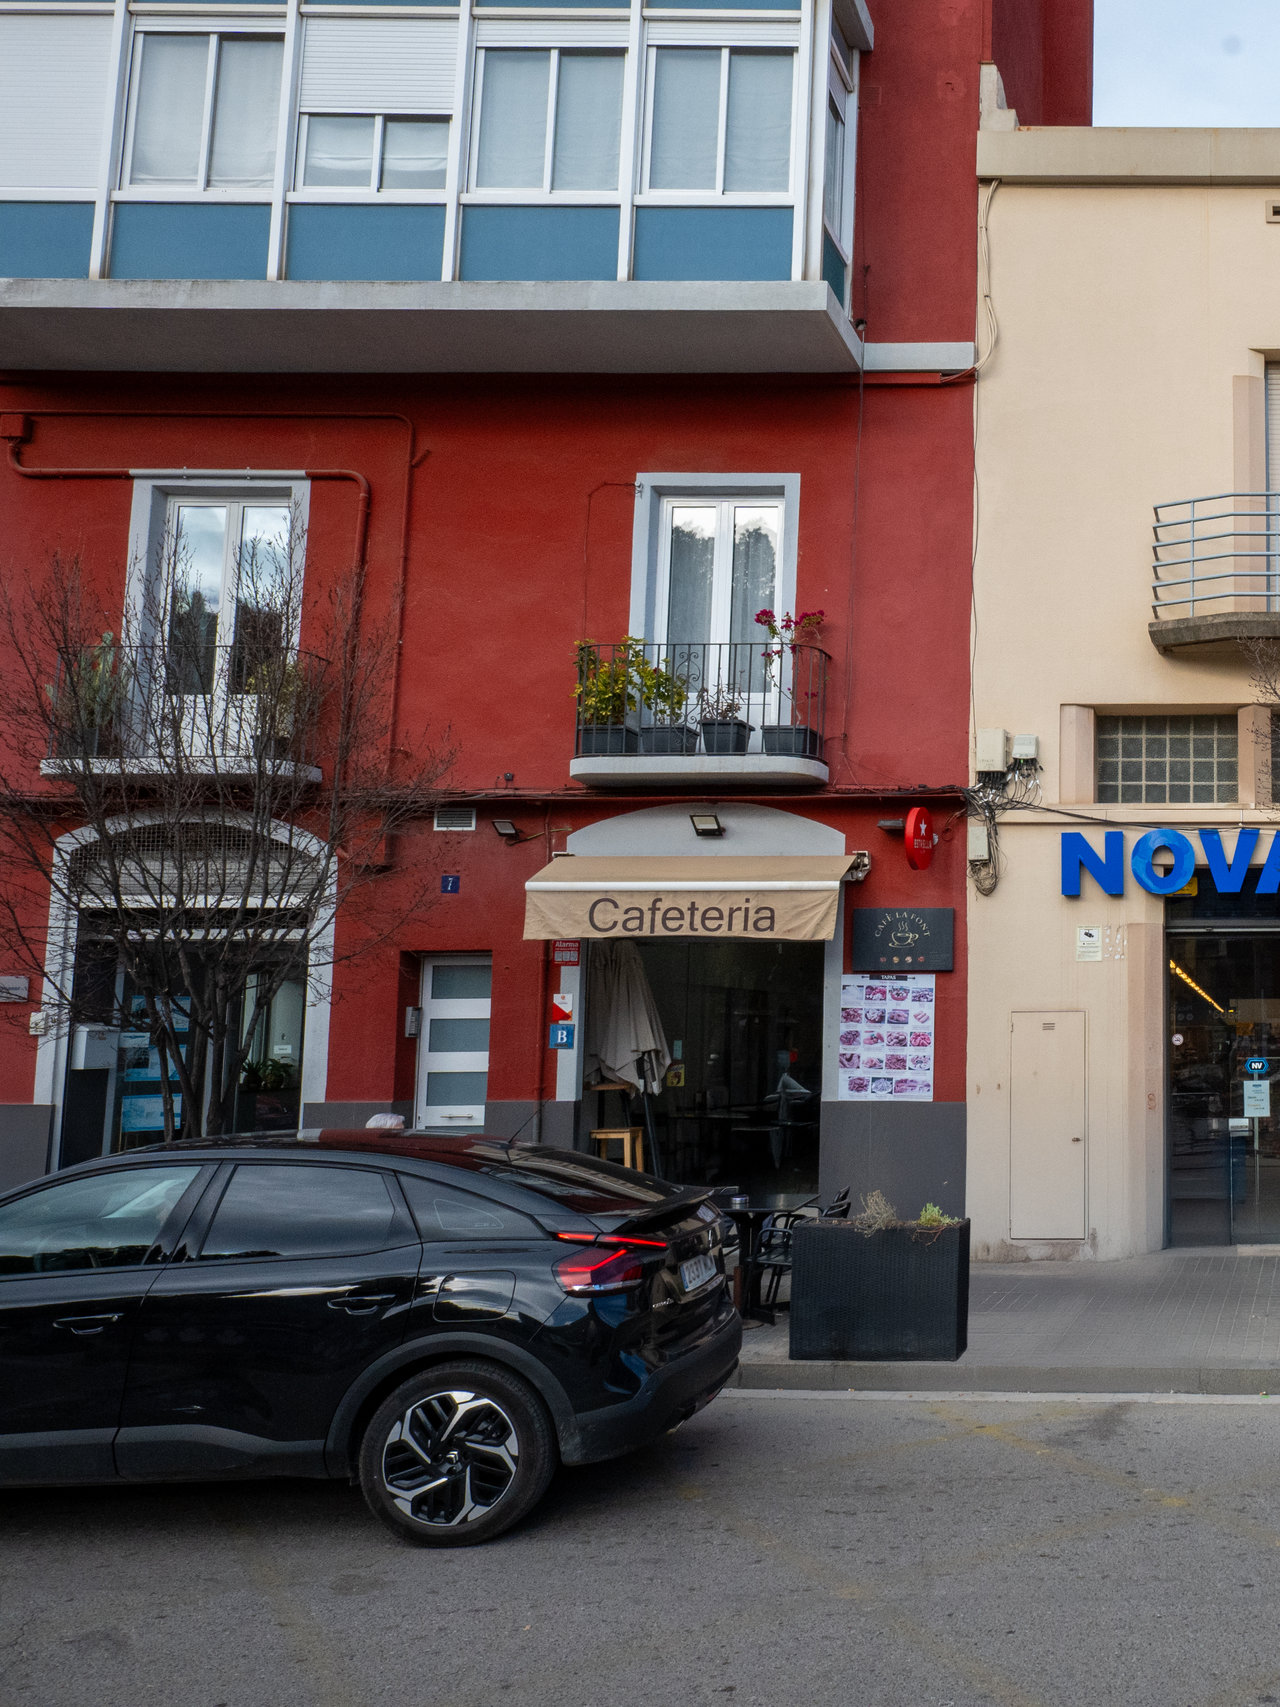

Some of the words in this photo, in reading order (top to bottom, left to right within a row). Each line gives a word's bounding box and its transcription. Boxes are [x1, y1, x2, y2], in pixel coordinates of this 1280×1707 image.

[447, 877, 454, 891] 7
[588, 897, 776, 935] Cafeteria
[895, 911, 908, 919] LA
[910, 913, 931, 937] FONT
[557, 1030, 568, 1043] B
